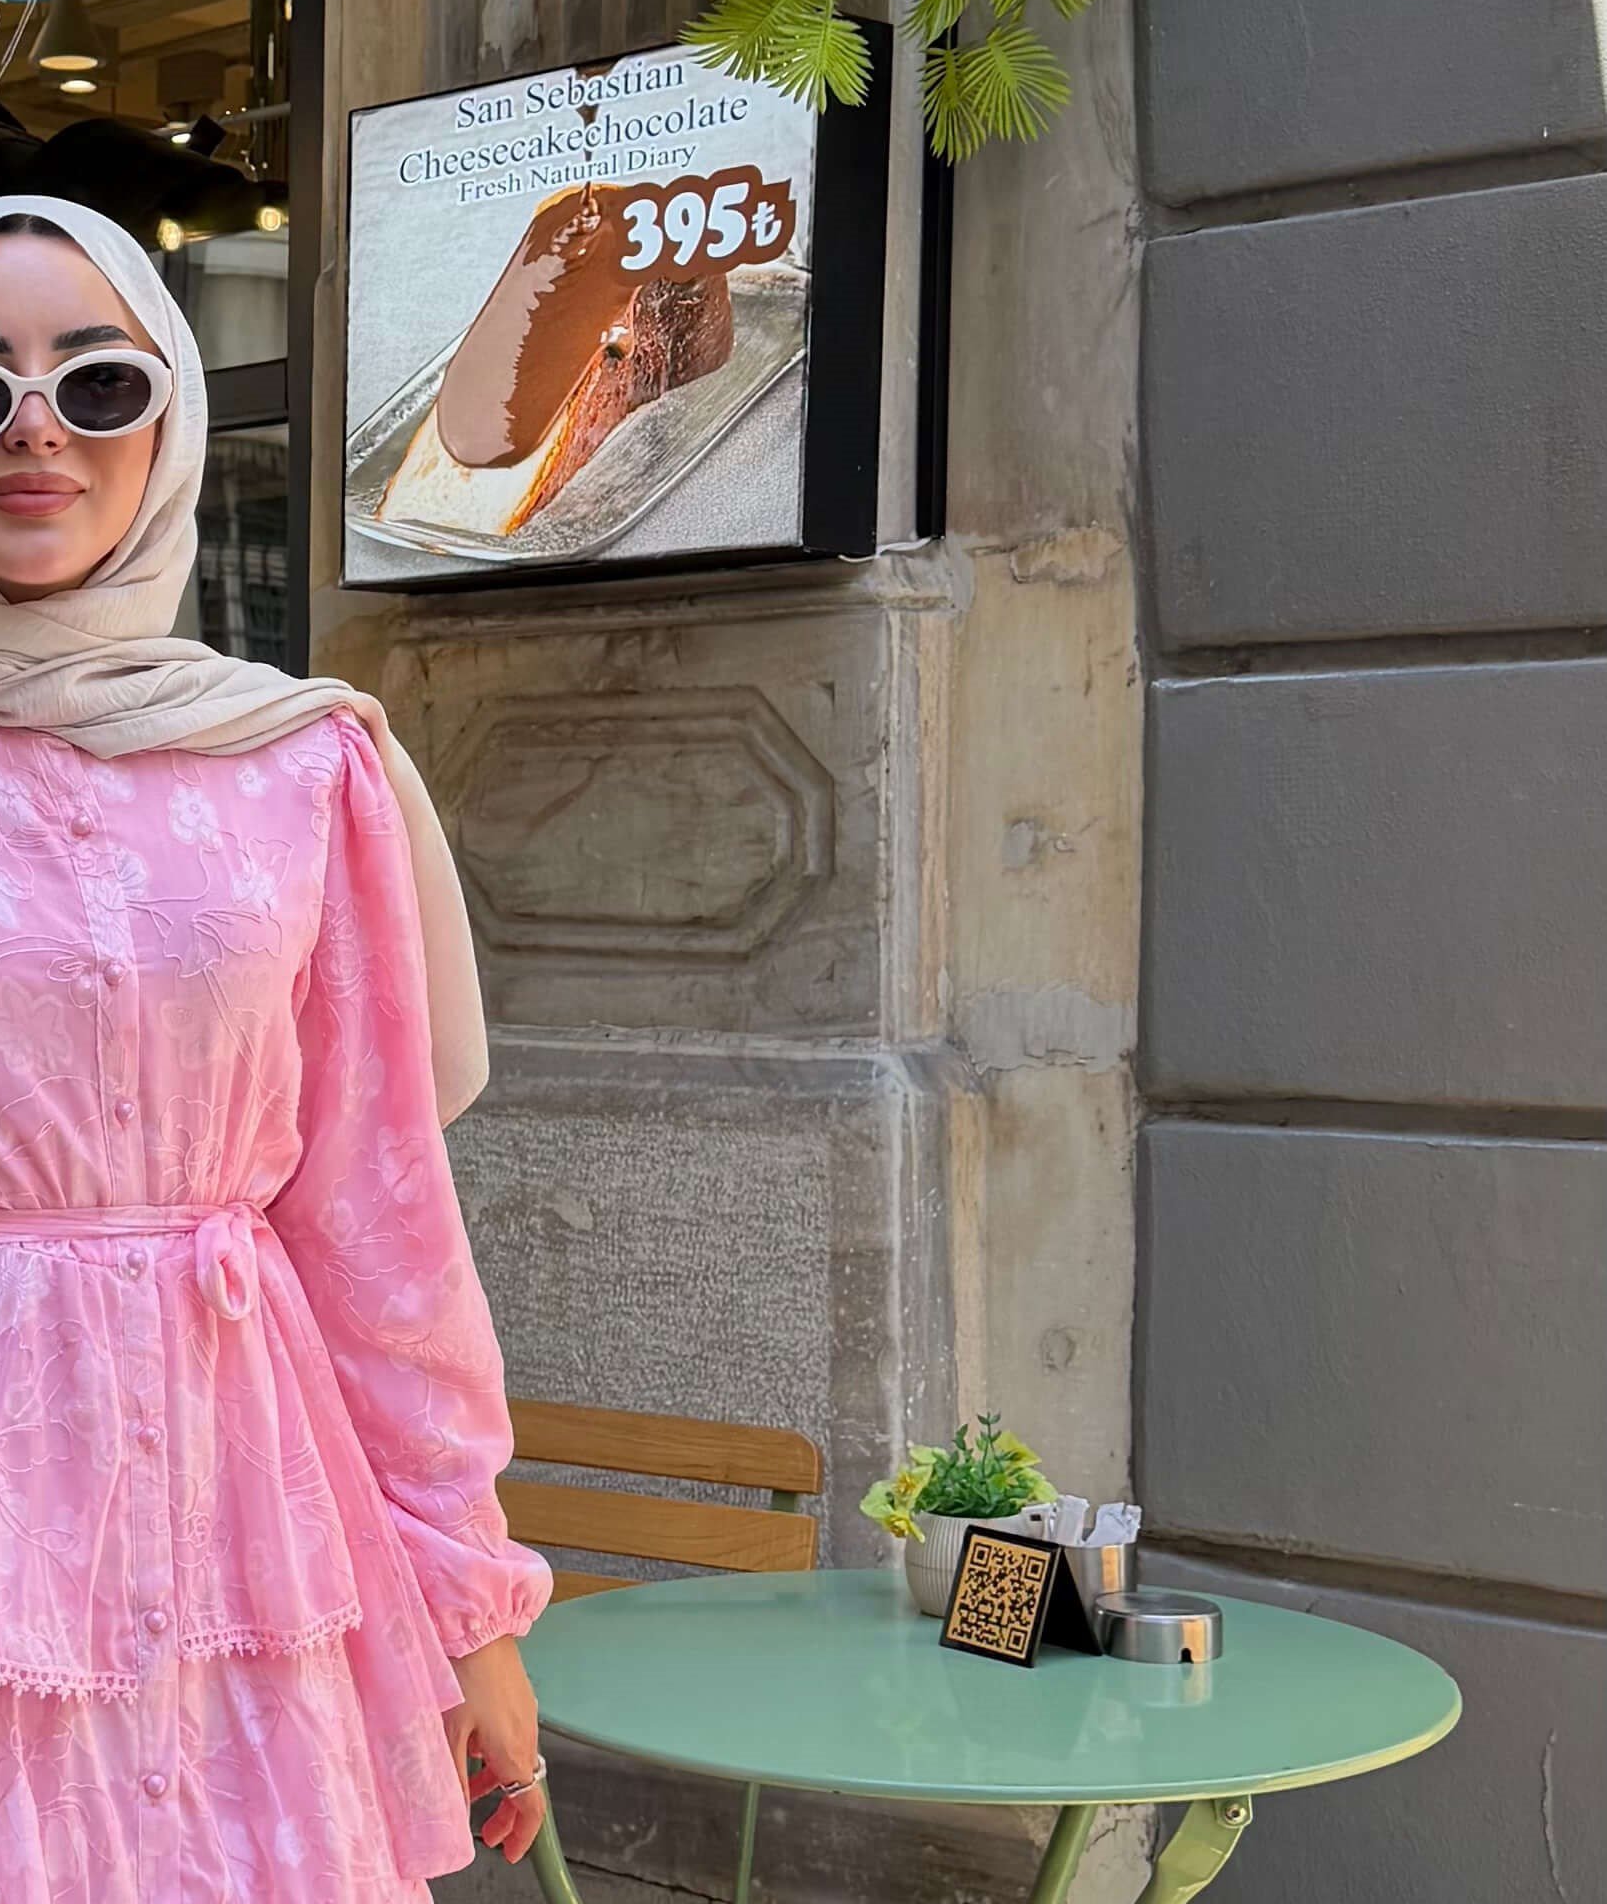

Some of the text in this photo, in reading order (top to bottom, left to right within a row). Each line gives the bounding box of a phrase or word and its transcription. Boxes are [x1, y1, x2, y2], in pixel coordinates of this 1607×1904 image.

[457, 62, 683, 129] San Sebastian
[399, 97, 748, 185] Cheesecakechocolate
[459, 146, 696, 202] Fresh Natural Diary
